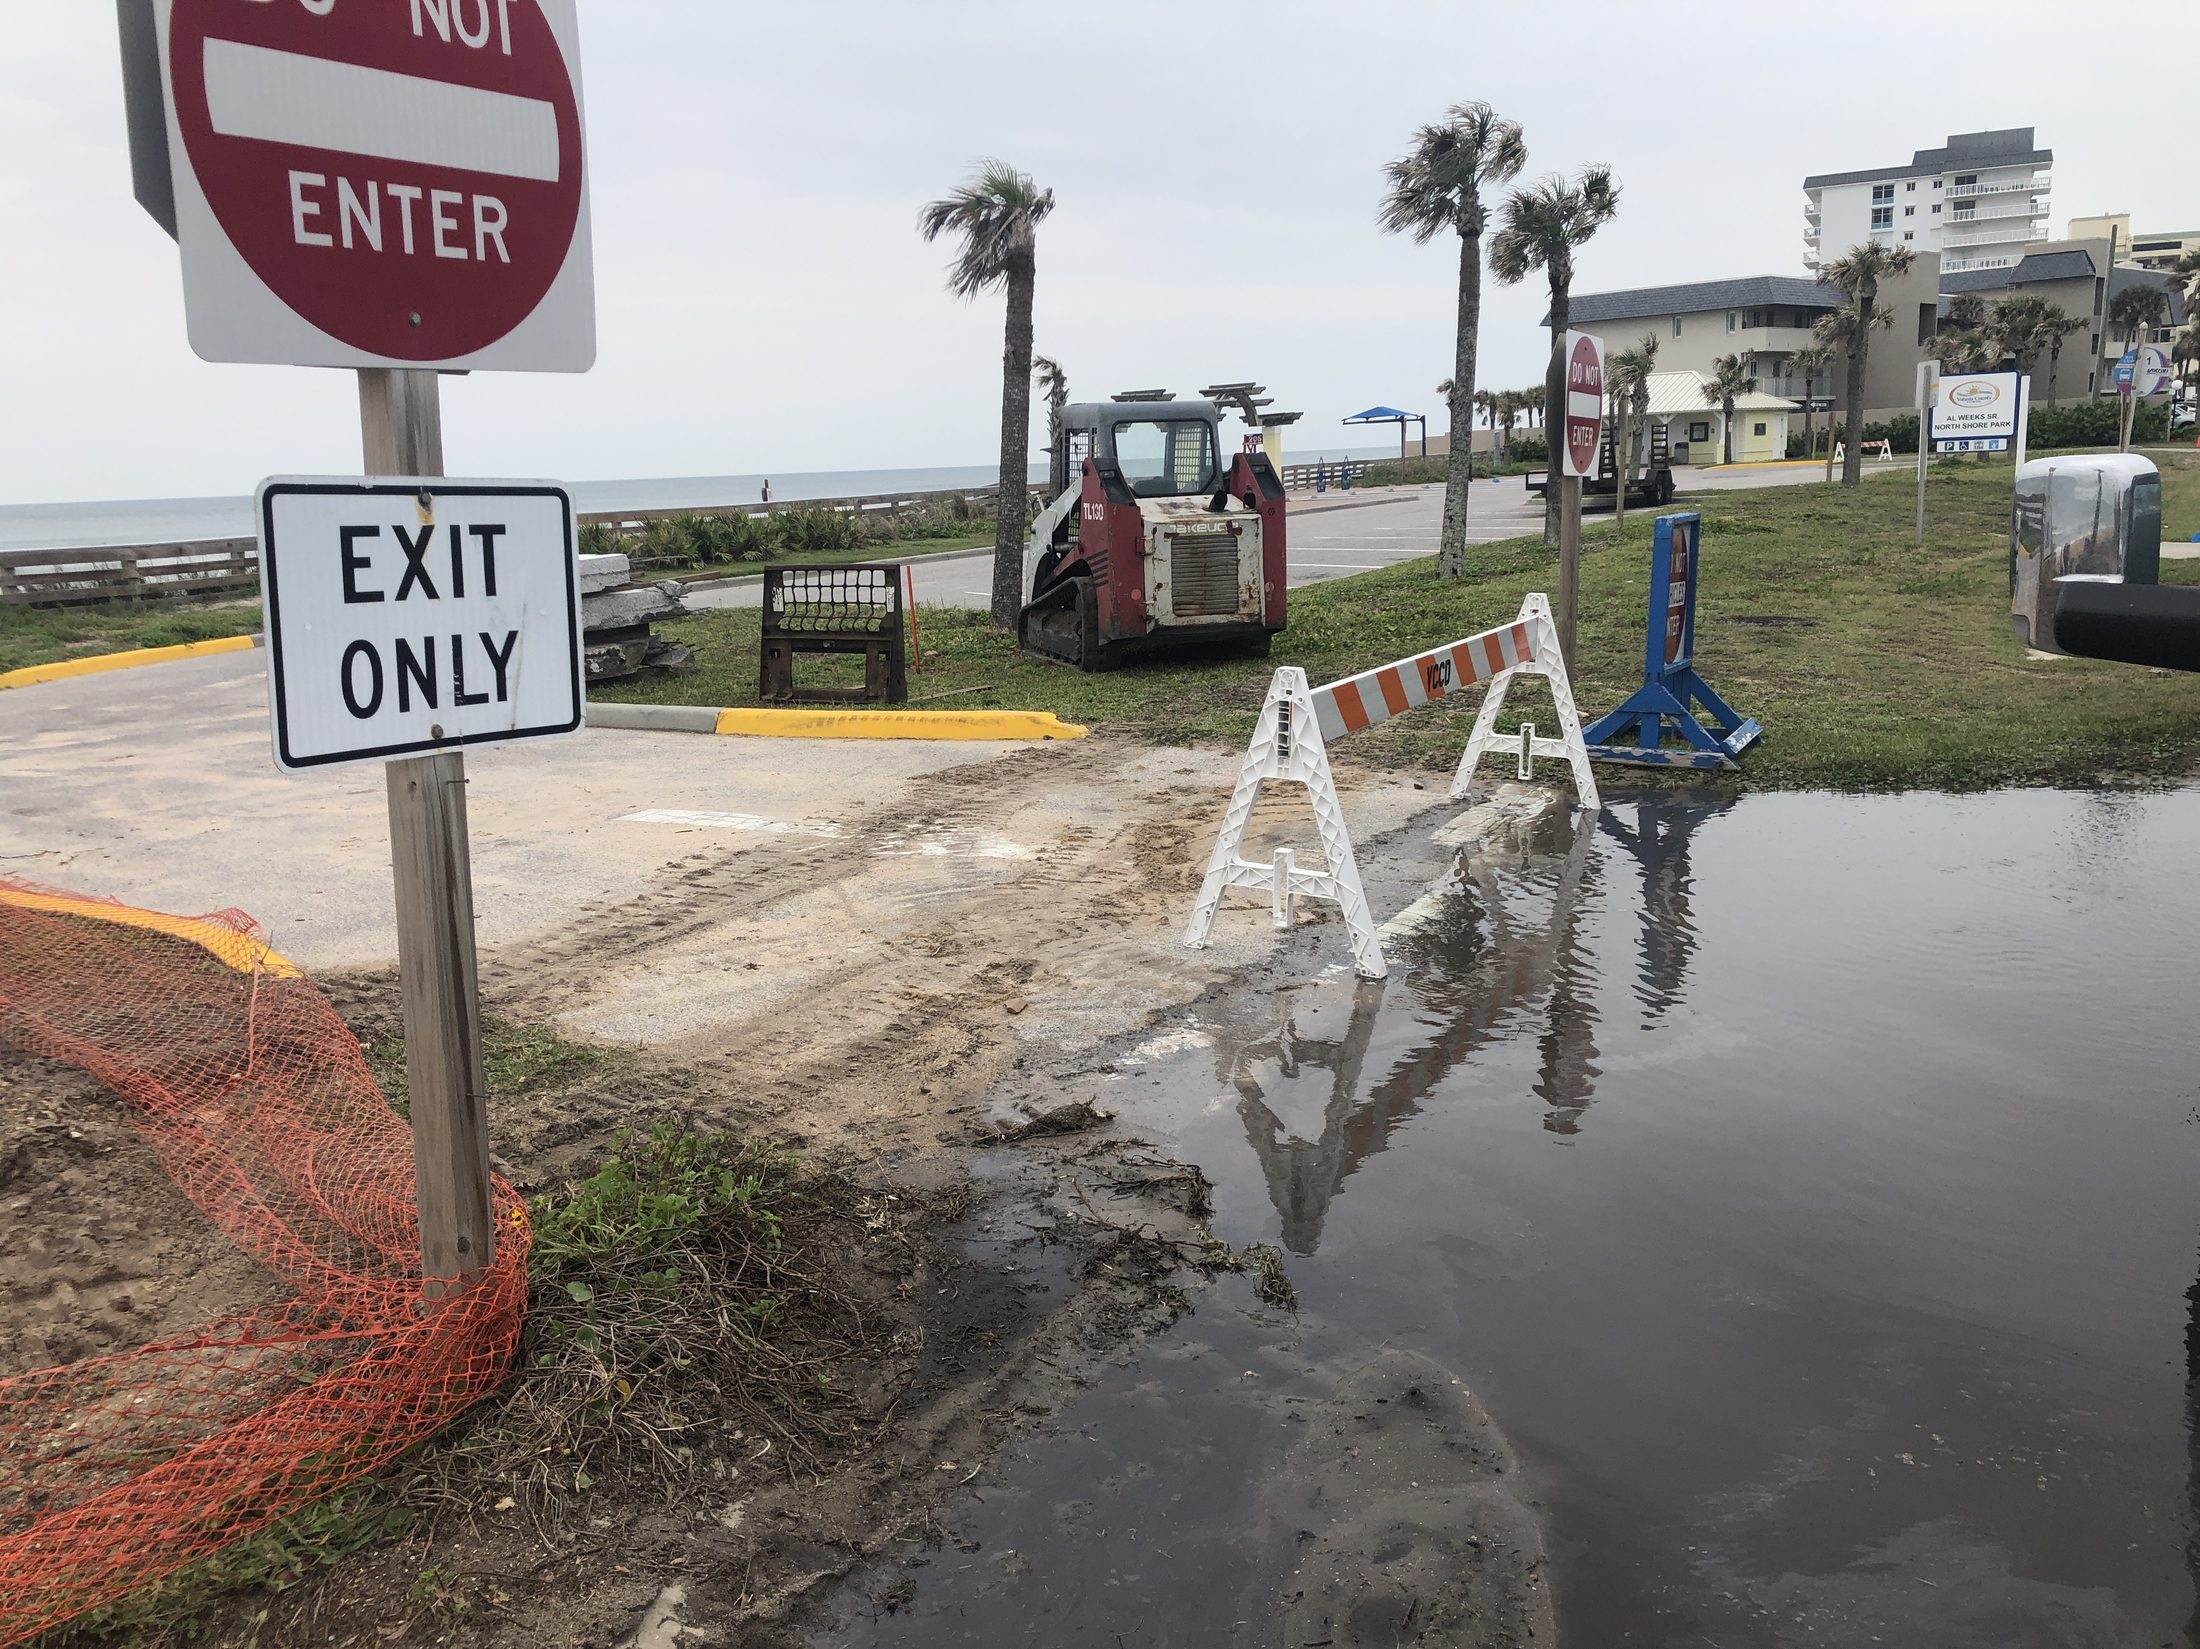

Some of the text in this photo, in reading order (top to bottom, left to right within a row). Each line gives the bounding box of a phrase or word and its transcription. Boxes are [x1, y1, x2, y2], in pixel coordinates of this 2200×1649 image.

[288, 169, 511, 263] ENTER
[1572, 361, 1599, 387] DO NOT
[1934, 423, 1960, 431] NORTH
[1958, 413, 1986, 421] WEEKS
[1572, 425, 1594, 447] ENTER
[1083, 502, 1104, 521] TL130
[339, 524, 506, 604] EXIT
[341, 630, 519, 719] ONLY
